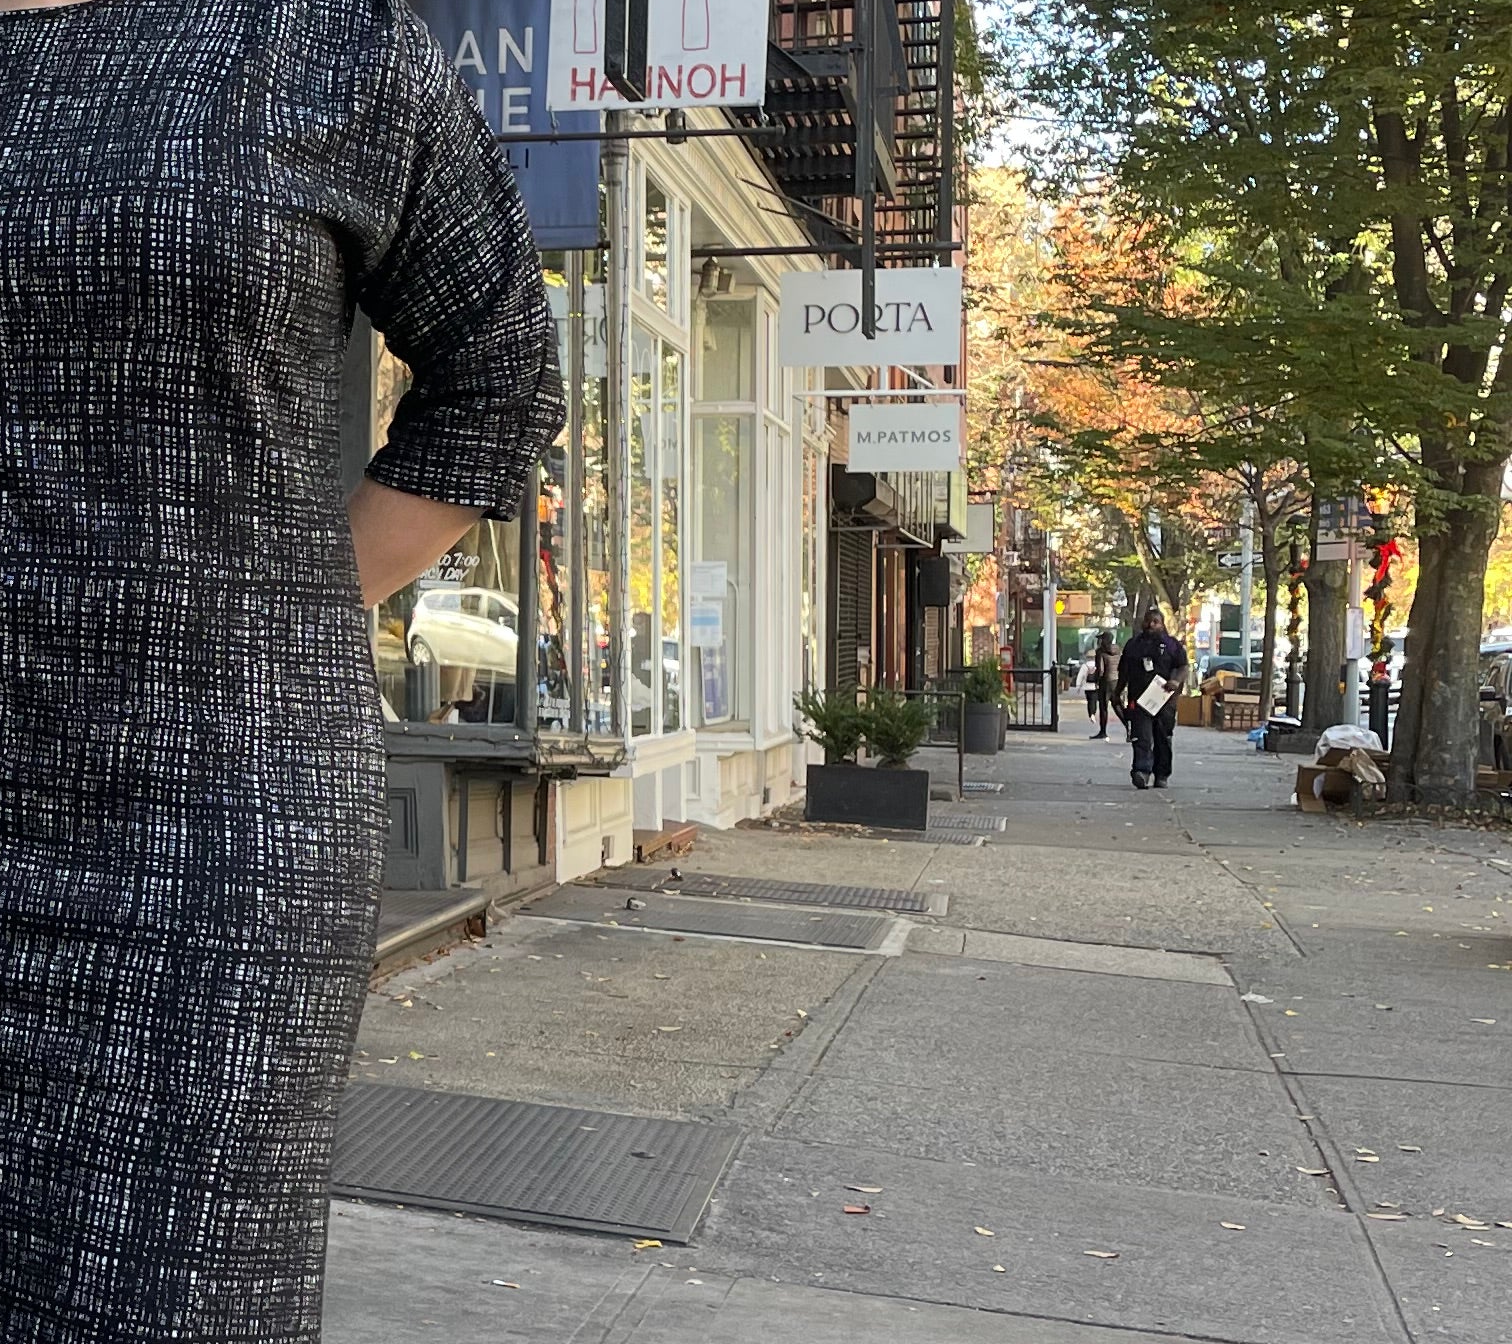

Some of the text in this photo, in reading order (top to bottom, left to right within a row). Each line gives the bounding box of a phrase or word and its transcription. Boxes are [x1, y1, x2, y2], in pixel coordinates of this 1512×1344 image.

[803, 302, 933, 334] PORTA
[857, 430, 952, 444] M.PATMOS
[453, 552, 480, 567] 7:00
[444, 567, 469, 581] DAY
